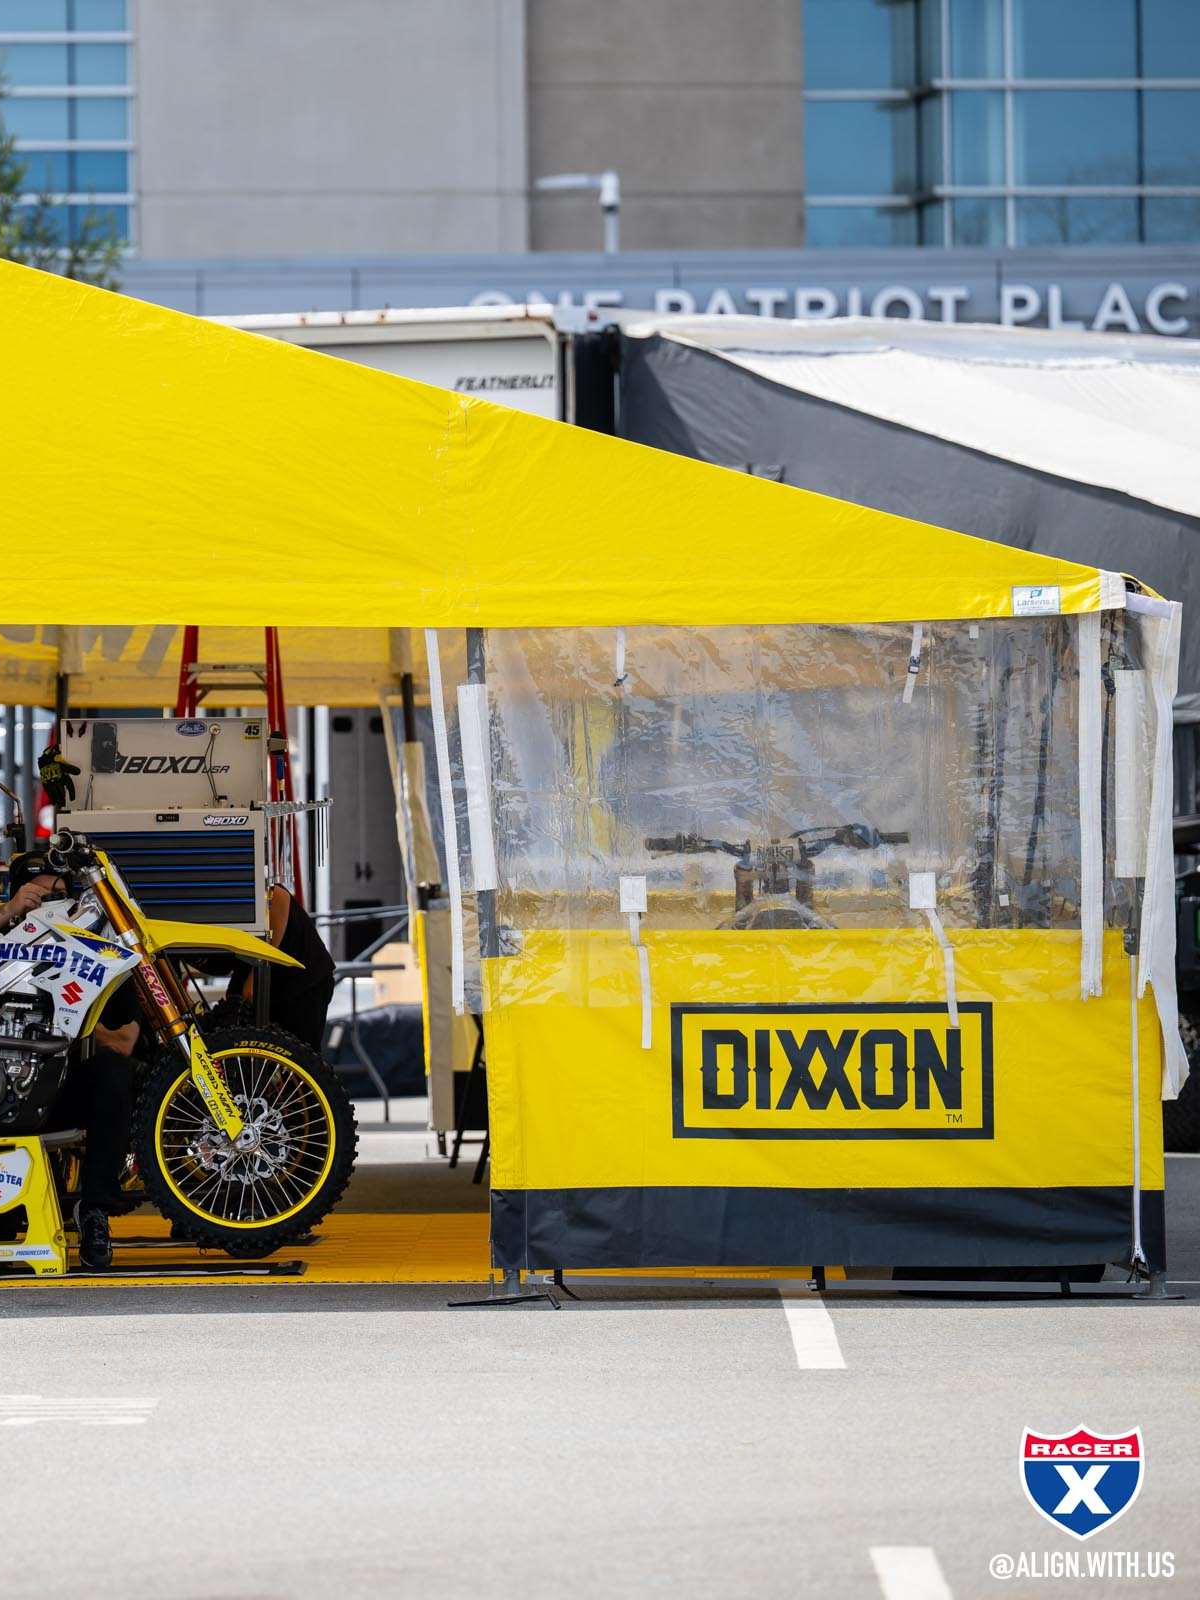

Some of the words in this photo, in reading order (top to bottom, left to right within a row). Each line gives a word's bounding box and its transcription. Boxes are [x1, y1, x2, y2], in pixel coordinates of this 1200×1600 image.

[244, 725, 260, 736] 45
[122, 756, 207, 774] BOXO
[212, 816, 248, 826] BOXO
[69, 951, 107, 988] TEA
[140, 964, 171, 1008] KYB
[240, 1041, 293, 1056] DUNLOP
[700, 1028, 965, 1110] DIXXON
[6, 1174, 23, 1187] TEA
